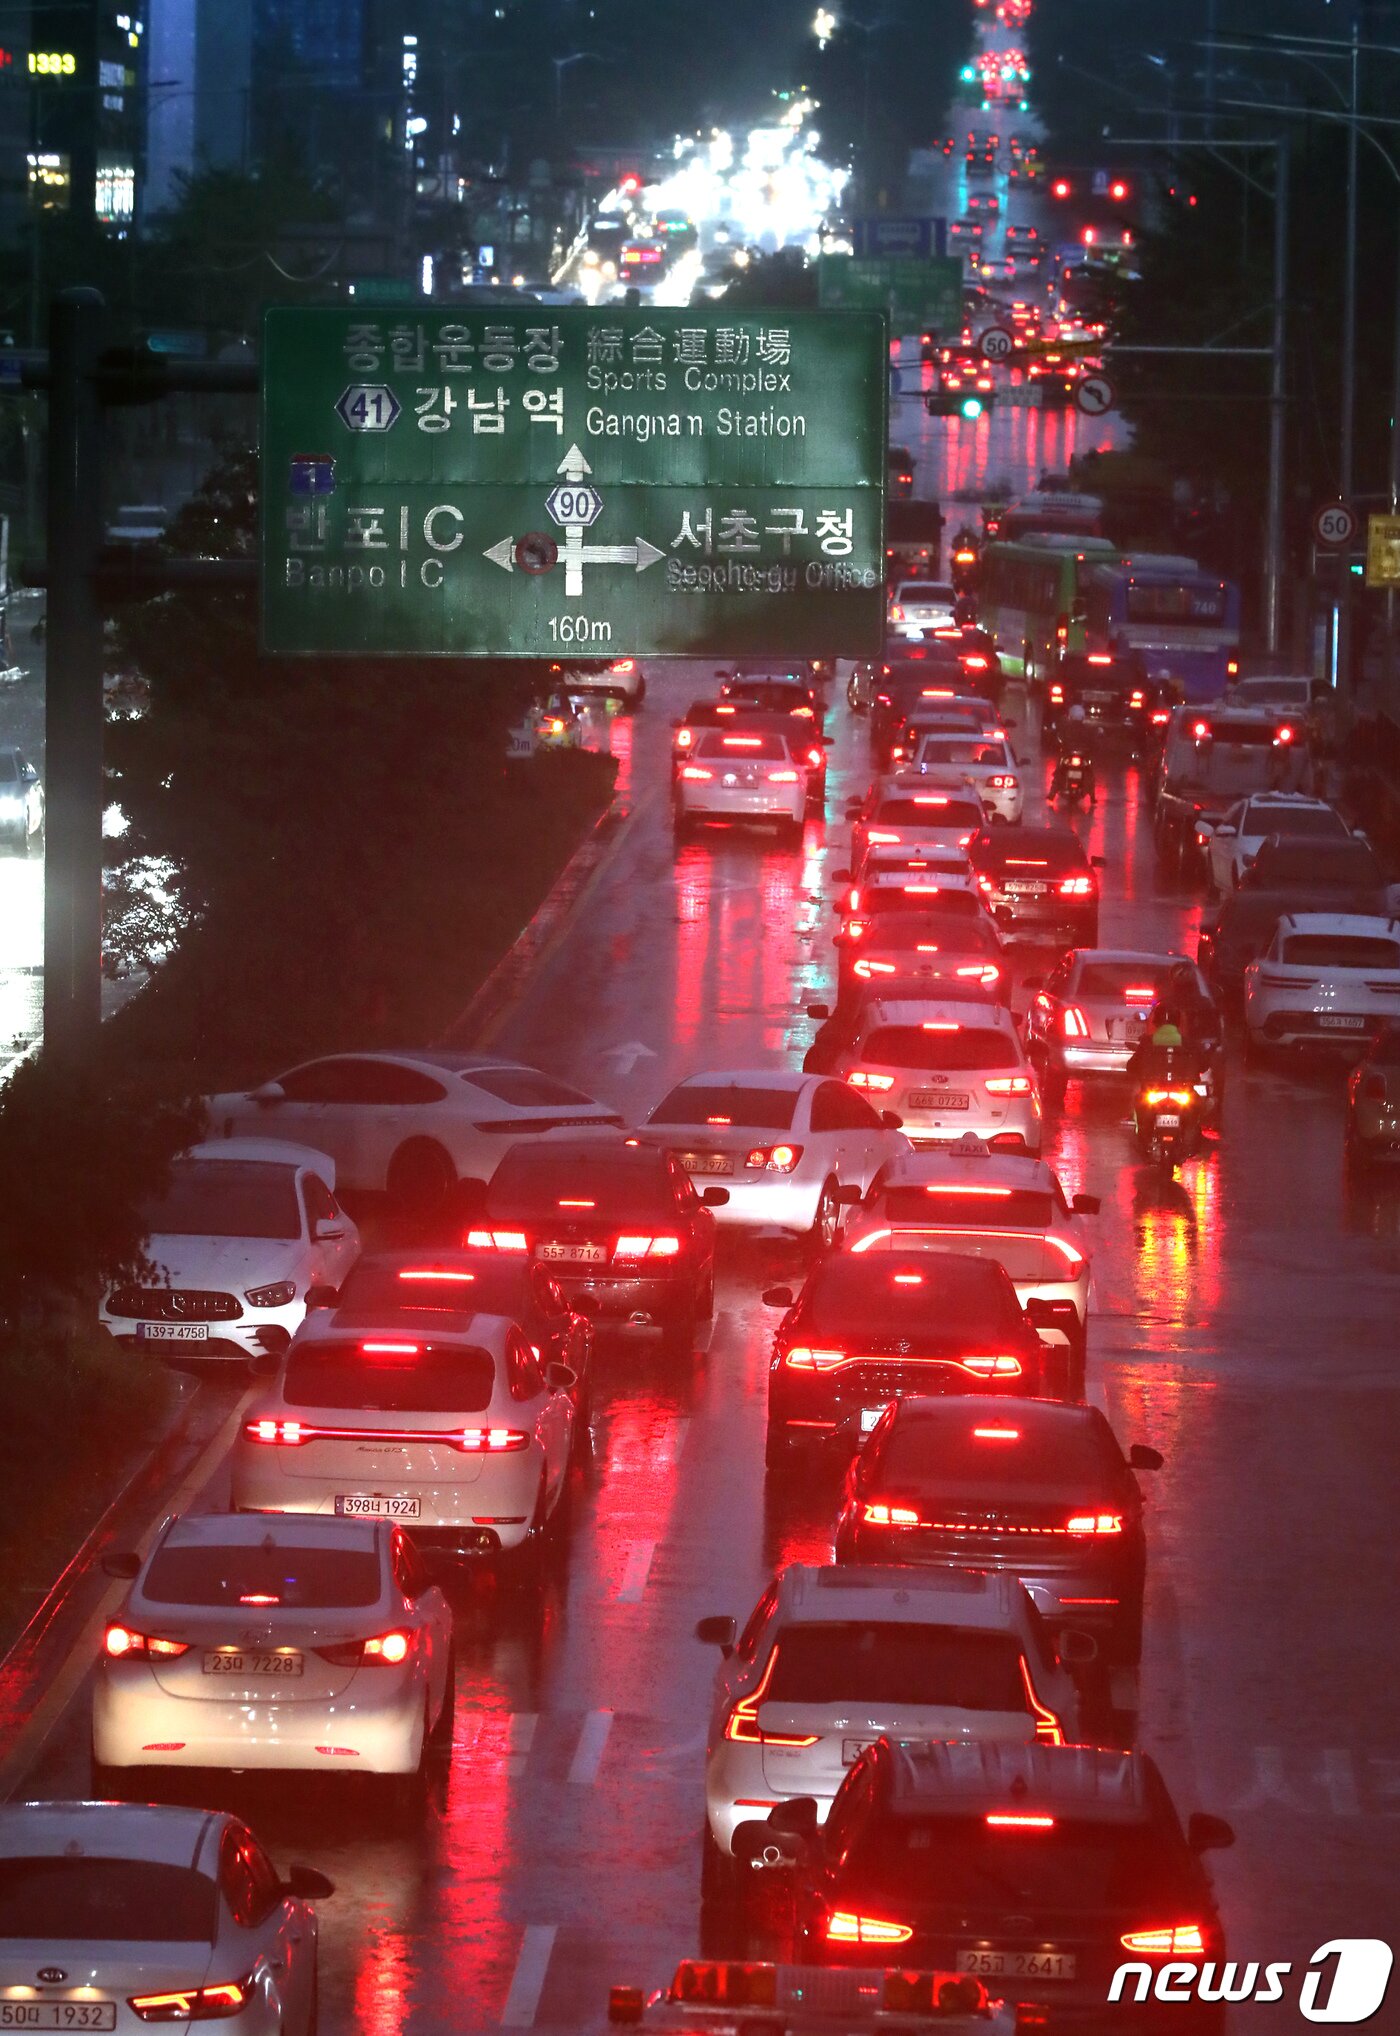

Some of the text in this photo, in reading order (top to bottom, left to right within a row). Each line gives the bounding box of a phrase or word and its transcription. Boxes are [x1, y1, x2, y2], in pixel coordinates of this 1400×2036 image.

[343, 324, 564, 373] 종합운동장
[587, 326, 791, 366] 綜合運動場
[985, 337, 1008, 354] 50
[587, 366, 791, 396] Sports Complex
[350, 393, 383, 424] 41
[414, 386, 564, 435] 강남역
[586, 406, 806, 442] Gangnam Station
[303, 467, 315, 492] 1
[560, 491, 590, 518] 90
[670, 508, 853, 556] 서초구청
[1322, 515, 1348, 535] 50
[286, 558, 384, 593] Banpo
[805, 560, 876, 589] Office
[548, 615, 612, 642] 160m
[938, 1096, 963, 1107] 0723
[959, 1144, 983, 1153] TAXI
[702, 1160, 728, 1171] 2972
[570, 1248, 600, 1260] 8716
[146, 1326, 205, 1339] 139구 4758
[345, 1499, 417, 1514] 398너 1924
[253, 1657, 293, 1672] 7228
[1015, 1955, 1064, 1976] 2641
[2, 2005, 103, 2026] 50마 1932
